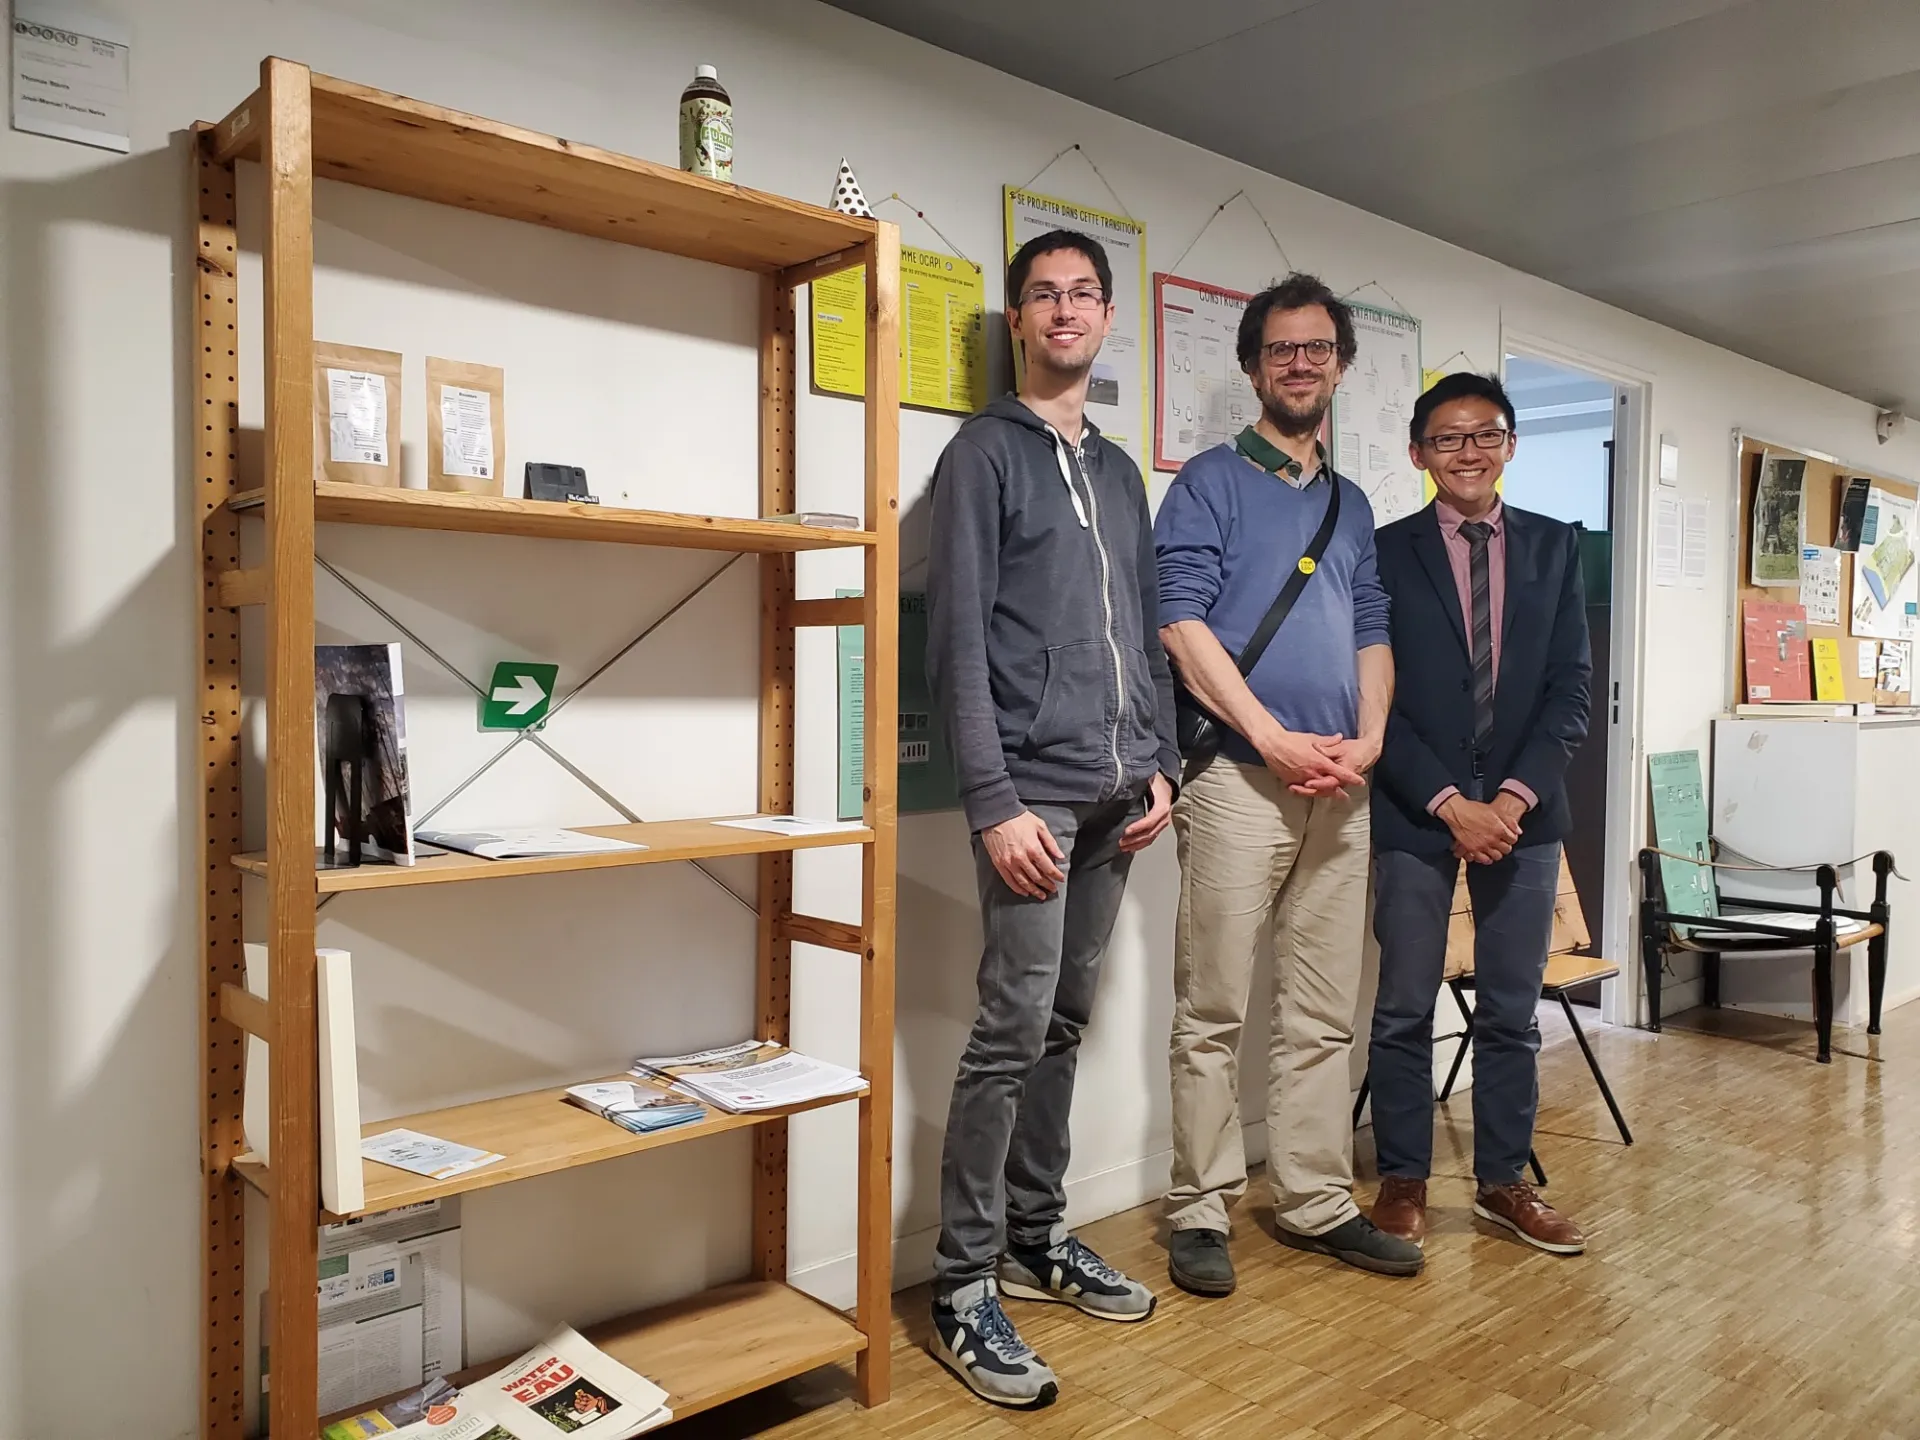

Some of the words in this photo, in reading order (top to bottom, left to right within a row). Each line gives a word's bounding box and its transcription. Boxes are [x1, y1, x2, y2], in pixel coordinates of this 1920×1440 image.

[1017, 193, 1025, 206] SE
[1027, 195, 1060, 215] PROJETER
[1062, 205, 1078, 220] DANS
[1080, 210, 1099, 226] CETTE
[1101, 216, 1137, 236] TRANSITION
[901, 249, 917, 264] MME
[920, 253, 941, 269] OCAPI
[1199, 287, 1244, 310] CONSTRUIRE
[900, 593, 926, 613] EXPÉ
[677, 1053, 709, 1061] NOTE
[501, 1357, 559, 1392] WATER
[512, 1364, 574, 1403] EAU
